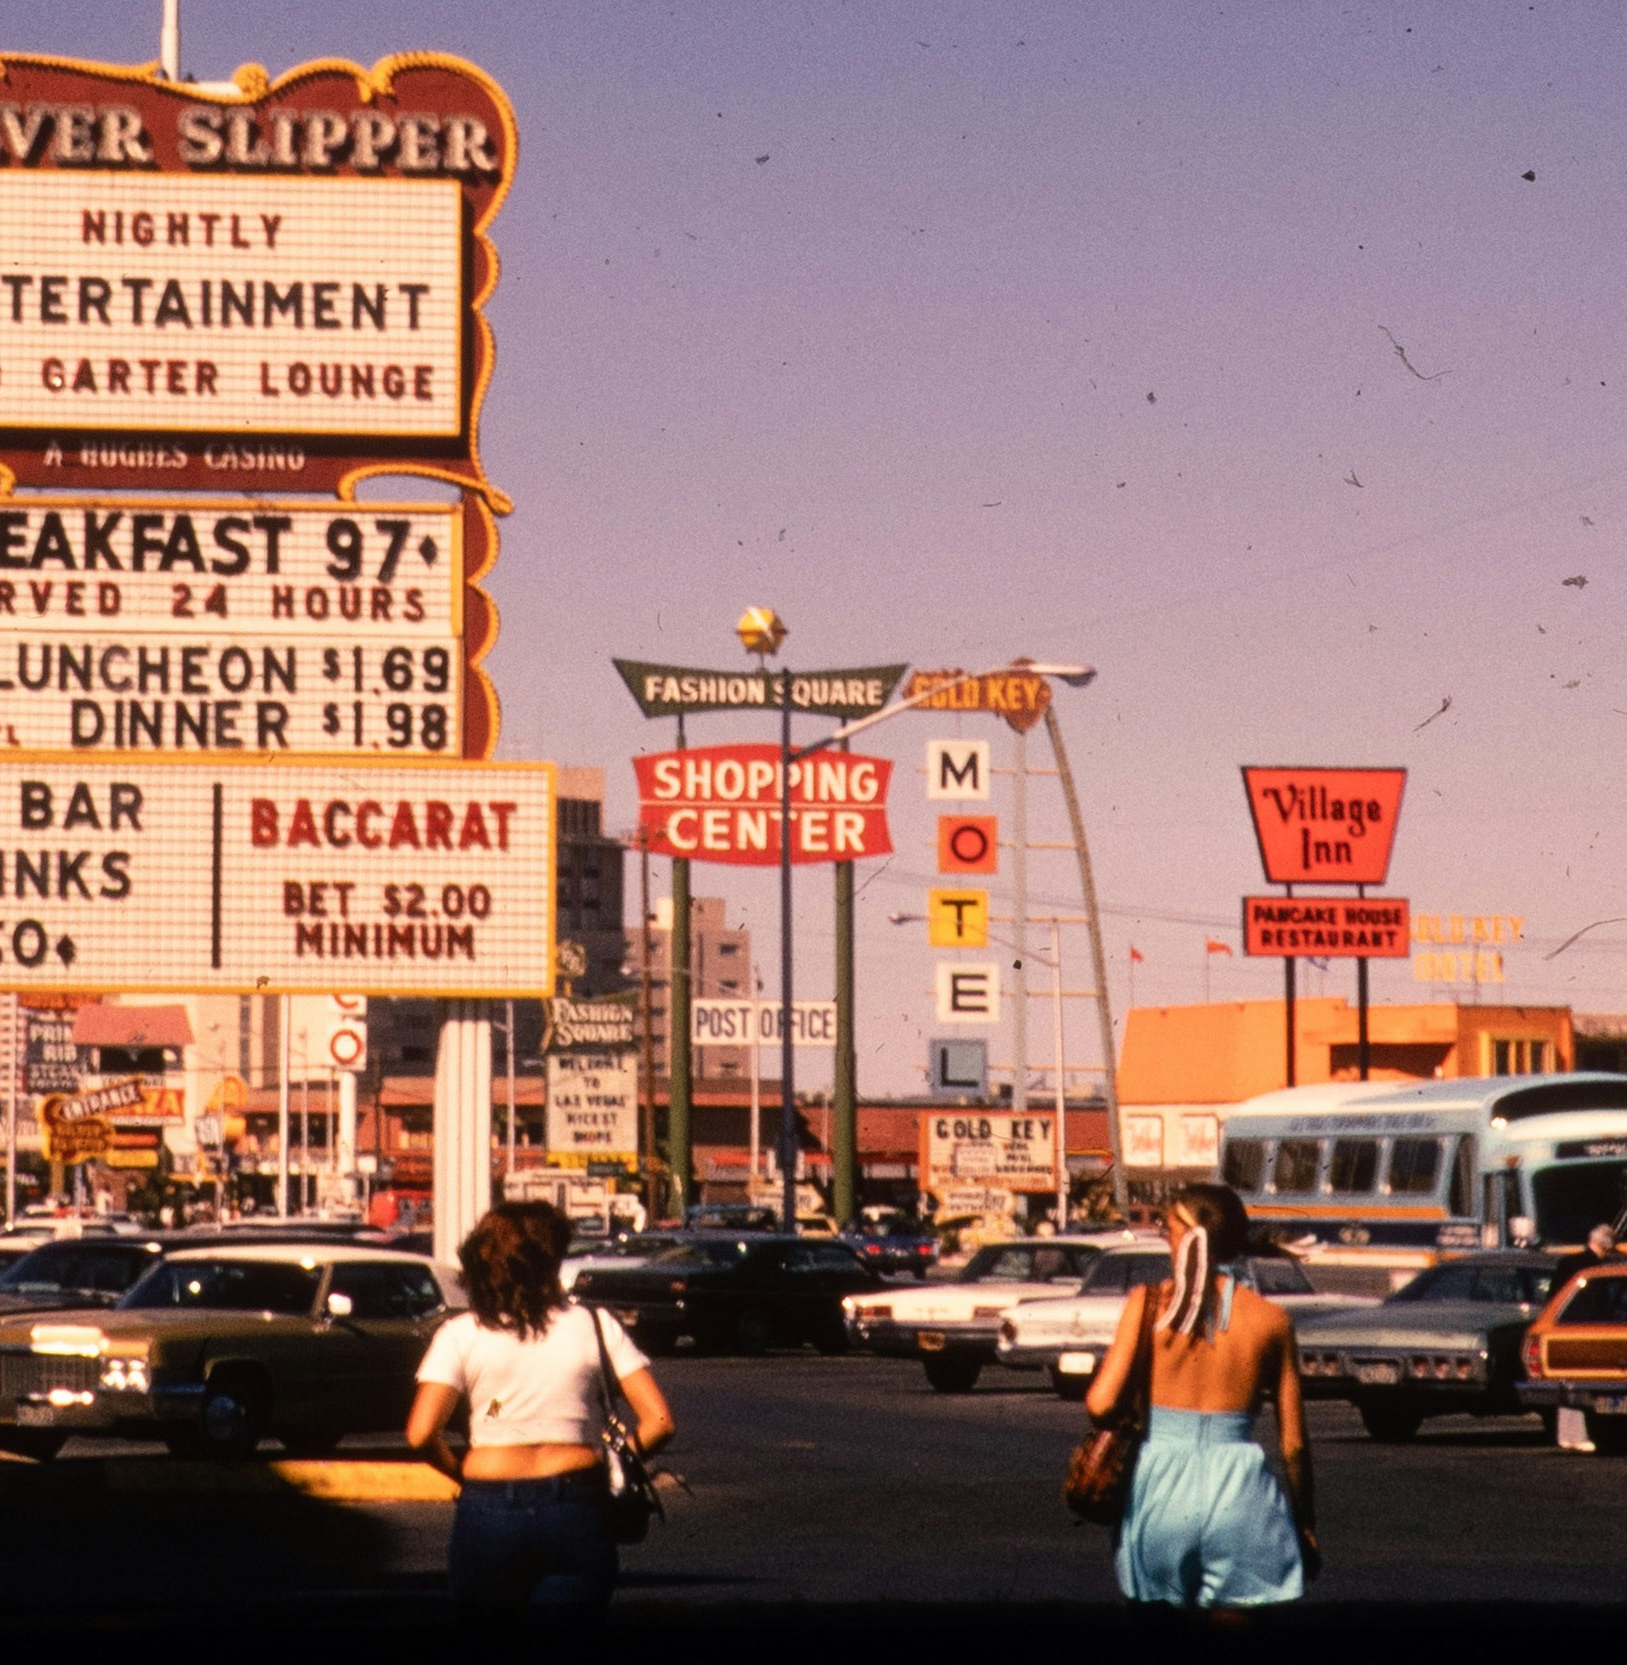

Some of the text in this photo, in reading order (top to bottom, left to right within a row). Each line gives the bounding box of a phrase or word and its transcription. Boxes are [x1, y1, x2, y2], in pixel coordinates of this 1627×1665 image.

[178, 109, 496, 172] SLIPPER
[82, 209, 283, 249] NIGHTLY
[42, 357, 218, 396] GARTER
[260, 363, 435, 401] LOUNGE
[203, 443, 306, 471] CASINO
[172, 583, 229, 618] 24
[272, 585, 427, 623] HOURS
[322, 645, 450, 696] $1.69
[644, 674, 766, 706] FASHION
[912, 672, 1042, 711] GOLD KEY
[71, 698, 449, 751] DINNER $1.98
[653, 758, 879, 803] SHOPPING
[21, 781, 144, 830] BAR
[251, 798, 517, 853] BACCARAT
[1263, 786, 1382, 836] Village
[667, 809, 866, 853] CENTER
[1301, 827, 1353, 870] Inn
[283, 881, 492, 920] BET $2.00
[939, 750, 989, 1088] MOTEL
[1252, 904, 1403, 928] PANCAKE HOUSE
[295, 924, 475, 959] MINIMUM
[1260, 928, 1398, 951] RESTAURANT
[1472, 915, 1524, 944] KEY
[696, 1007, 751, 1038] POST
[62, 1081, 142, 1122] ENTRANCE
[936, 1118, 1052, 1140] GOLD KEY
